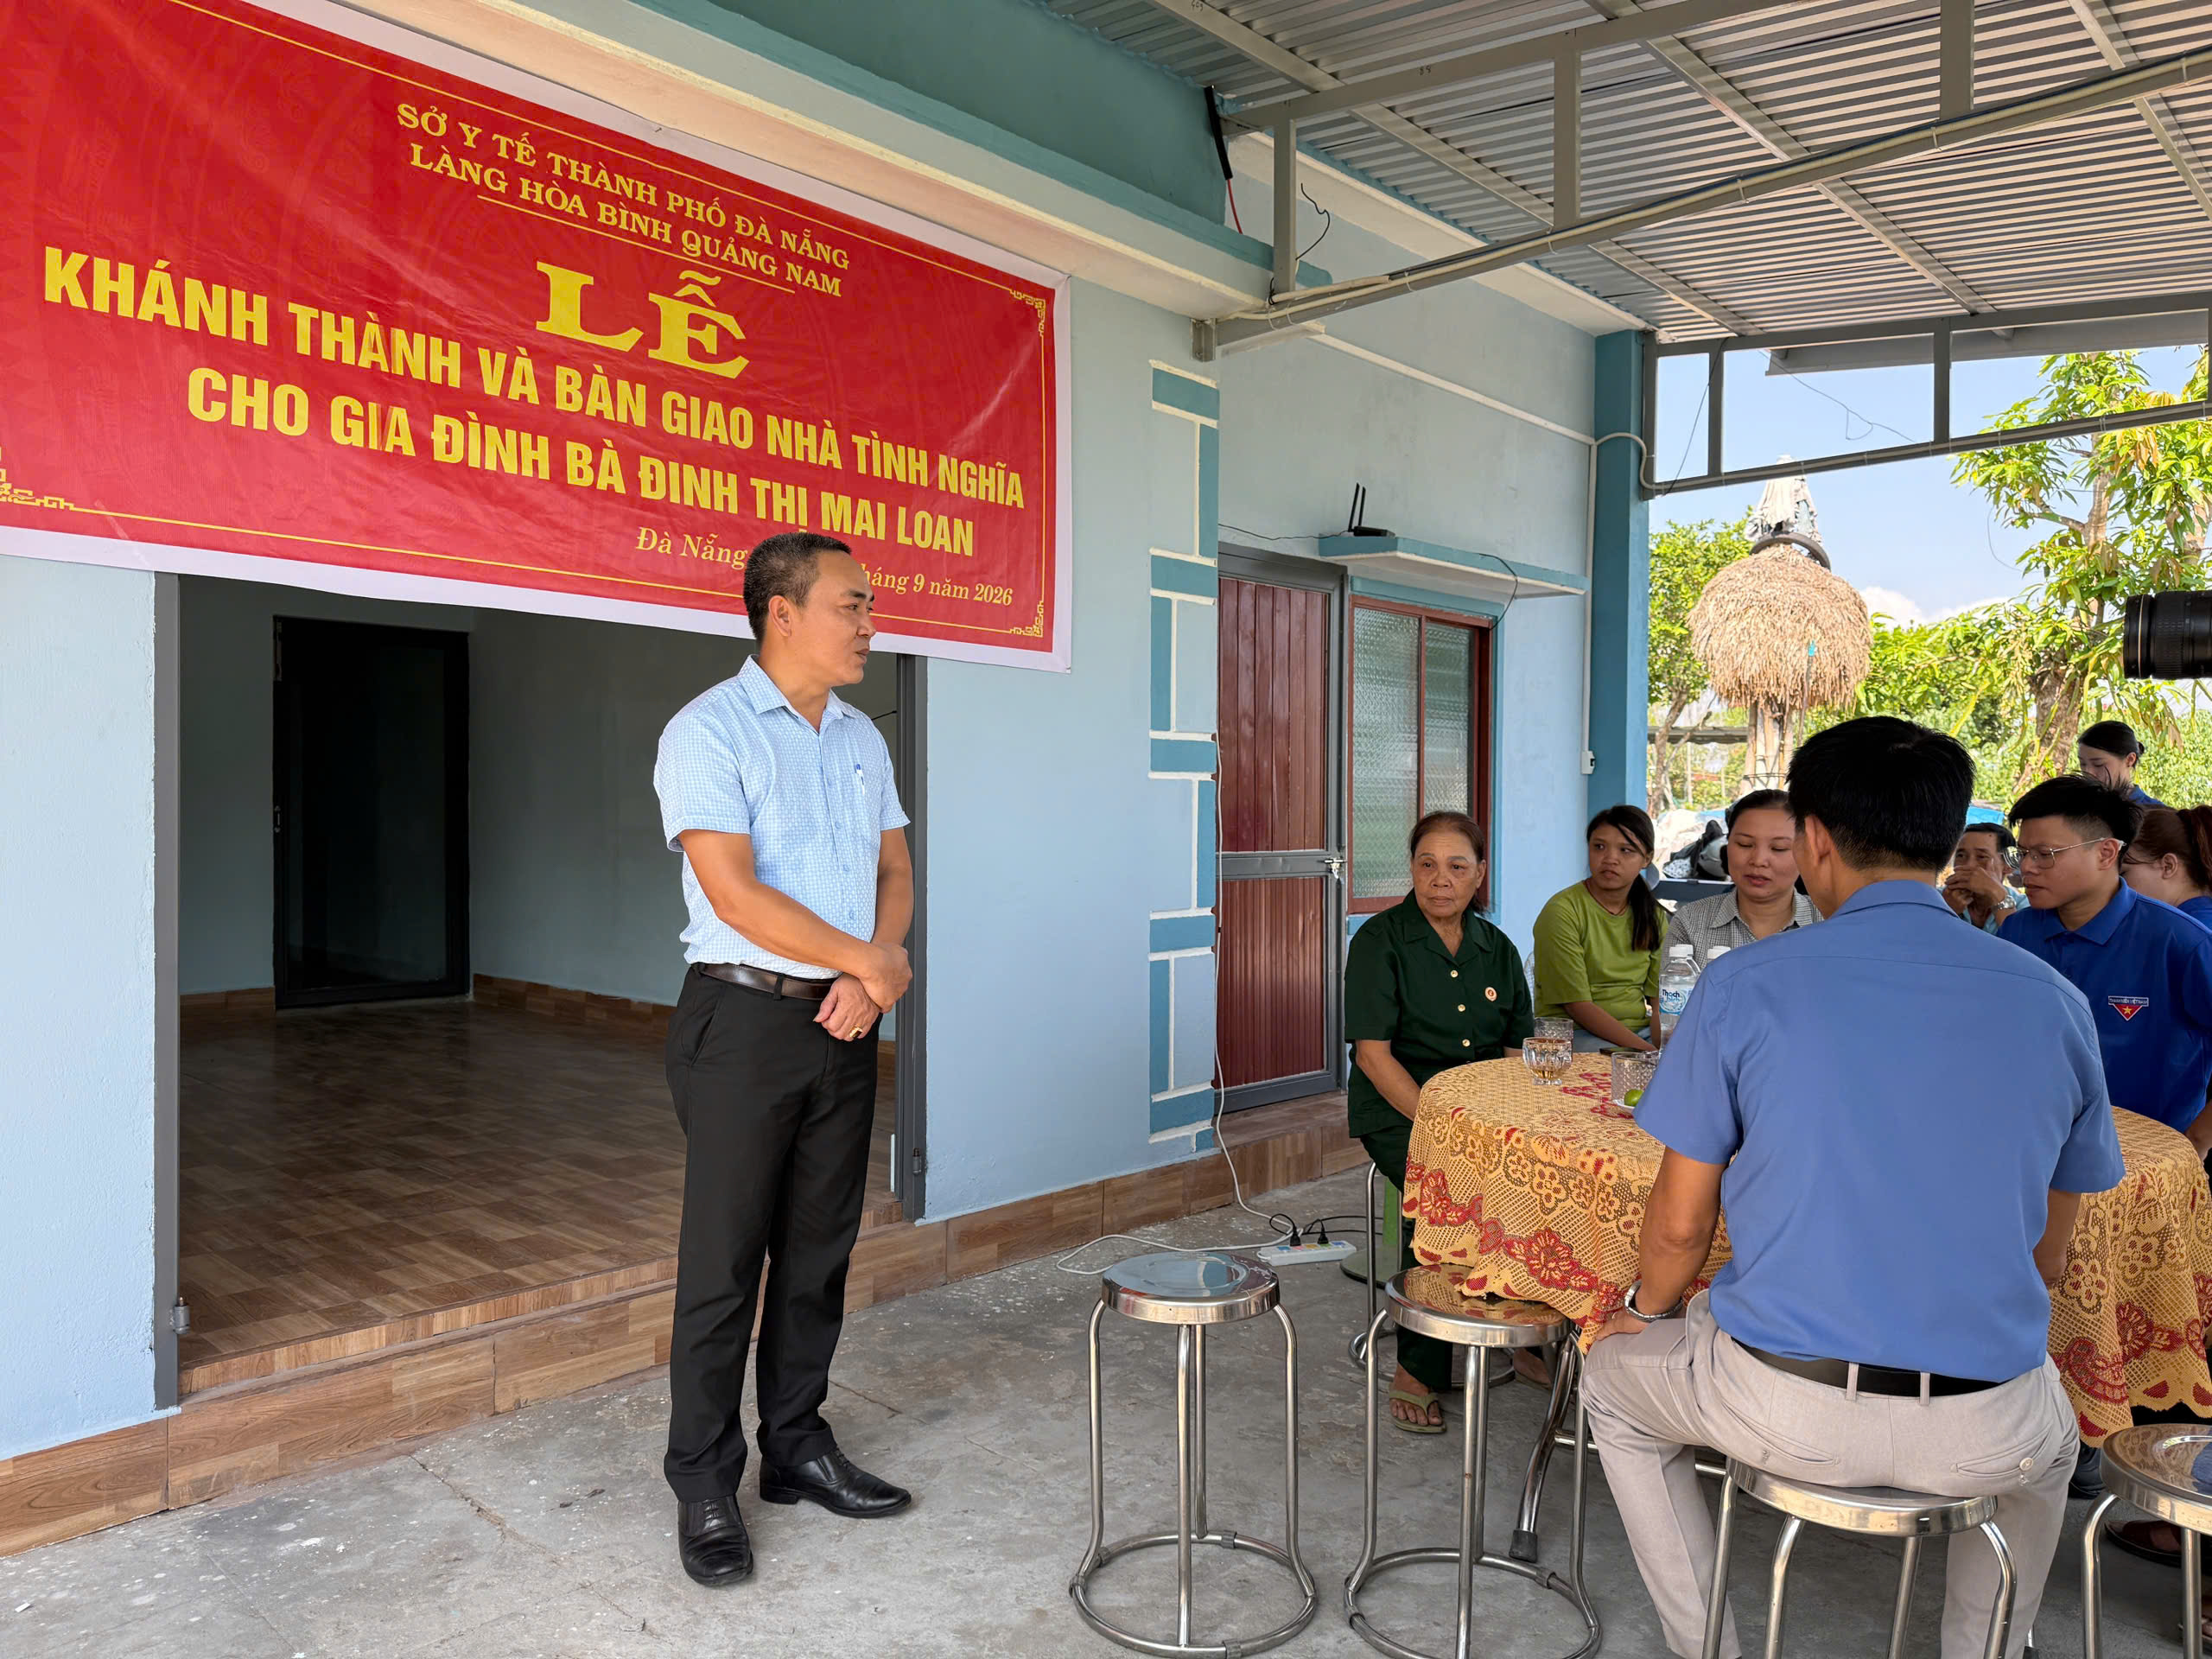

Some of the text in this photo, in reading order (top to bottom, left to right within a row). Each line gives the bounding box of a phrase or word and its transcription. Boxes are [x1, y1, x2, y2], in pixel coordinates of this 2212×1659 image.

[397, 102, 851, 271] SỞ Y TẾ THÀNH PHỐ ĐÀ NẴNG
[410, 142, 842, 297] LÀNG HÒA BÌNH QUẢNG NAM
[43, 245, 1025, 510] KHÁNH THÀNH VÀ BÀN GIAO NHÀ TÌNH NGHĨA
[536, 262, 750, 379] LỄ
[188, 366, 975, 557] CHO GIA ĐÌNH BÀ ĐINH THỊ MAI LOAN
[635, 526, 1014, 607] Đà Nẵng háng 9 năm 2026
